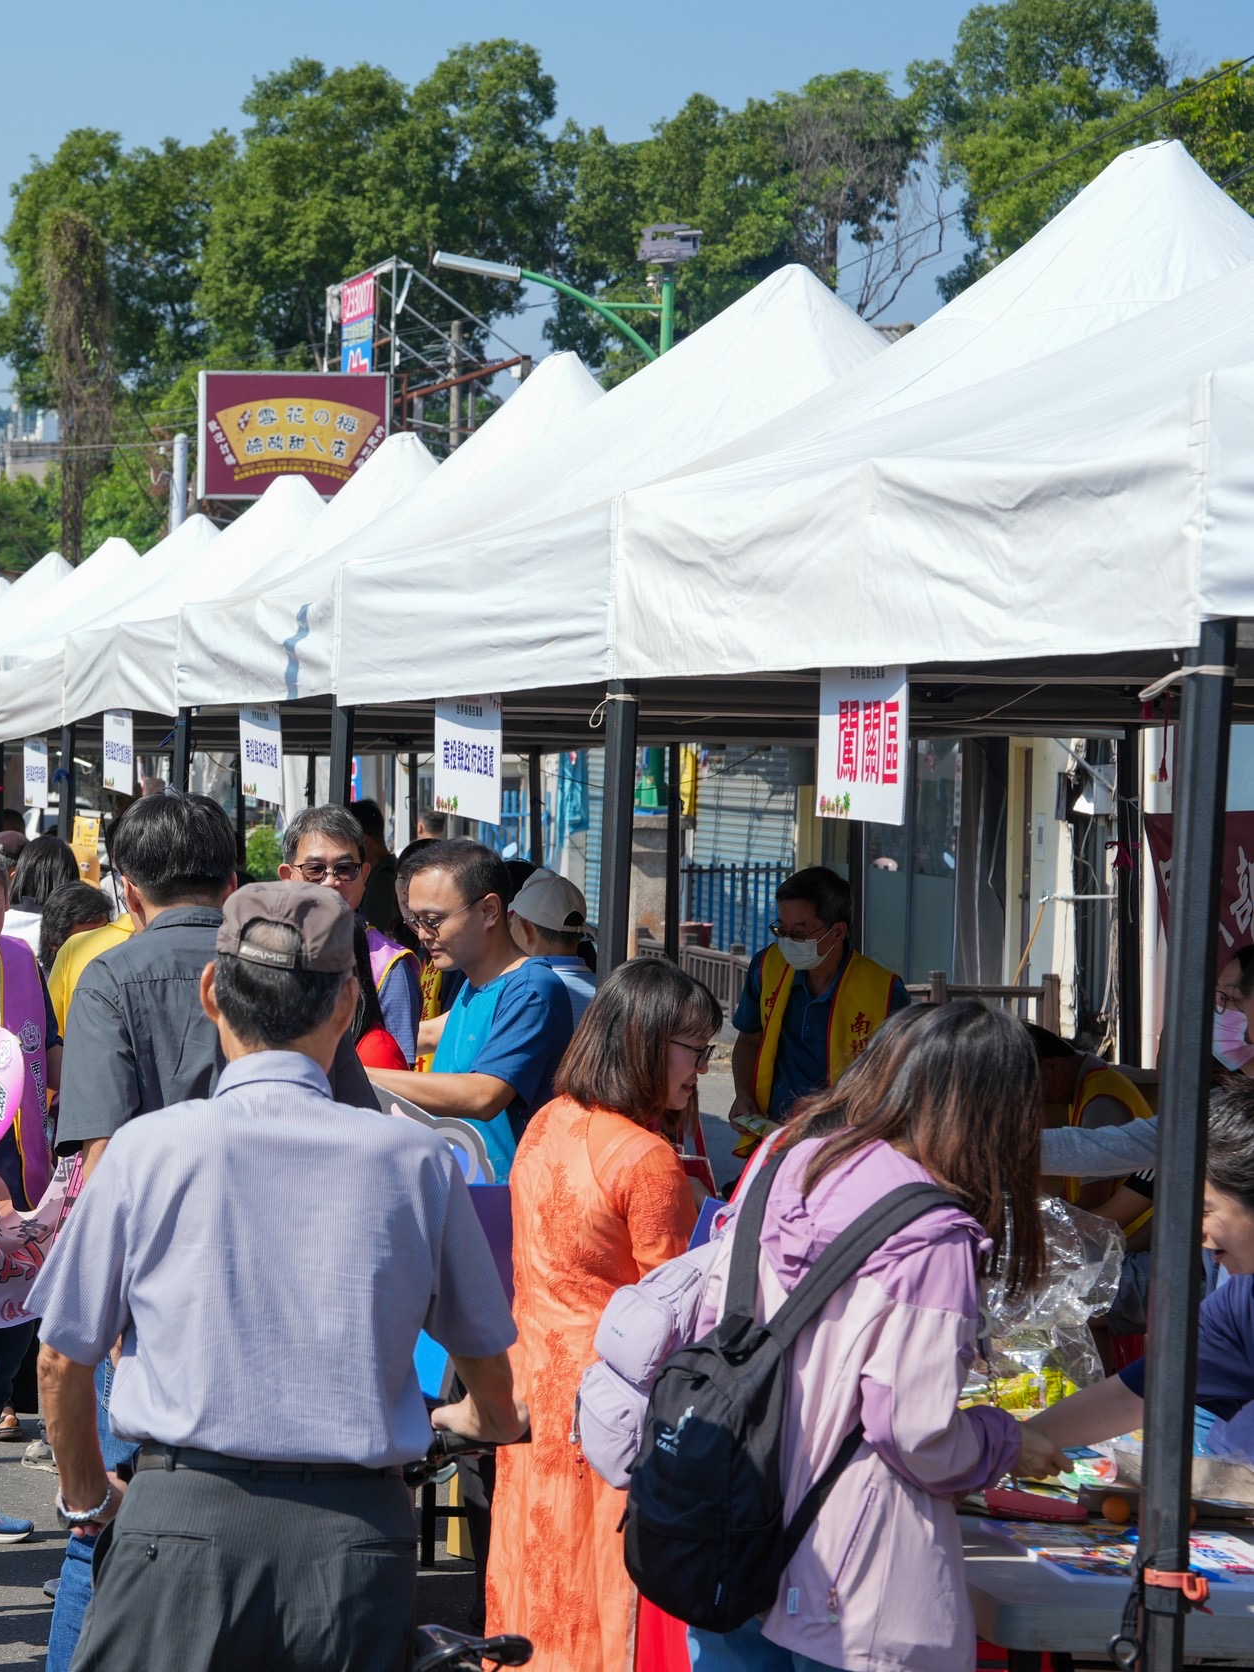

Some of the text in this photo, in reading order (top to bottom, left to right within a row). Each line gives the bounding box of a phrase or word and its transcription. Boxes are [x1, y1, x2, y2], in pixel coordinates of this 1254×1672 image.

[837, 700, 899, 785] 闖關區
[251, 950, 288, 963] AMG
